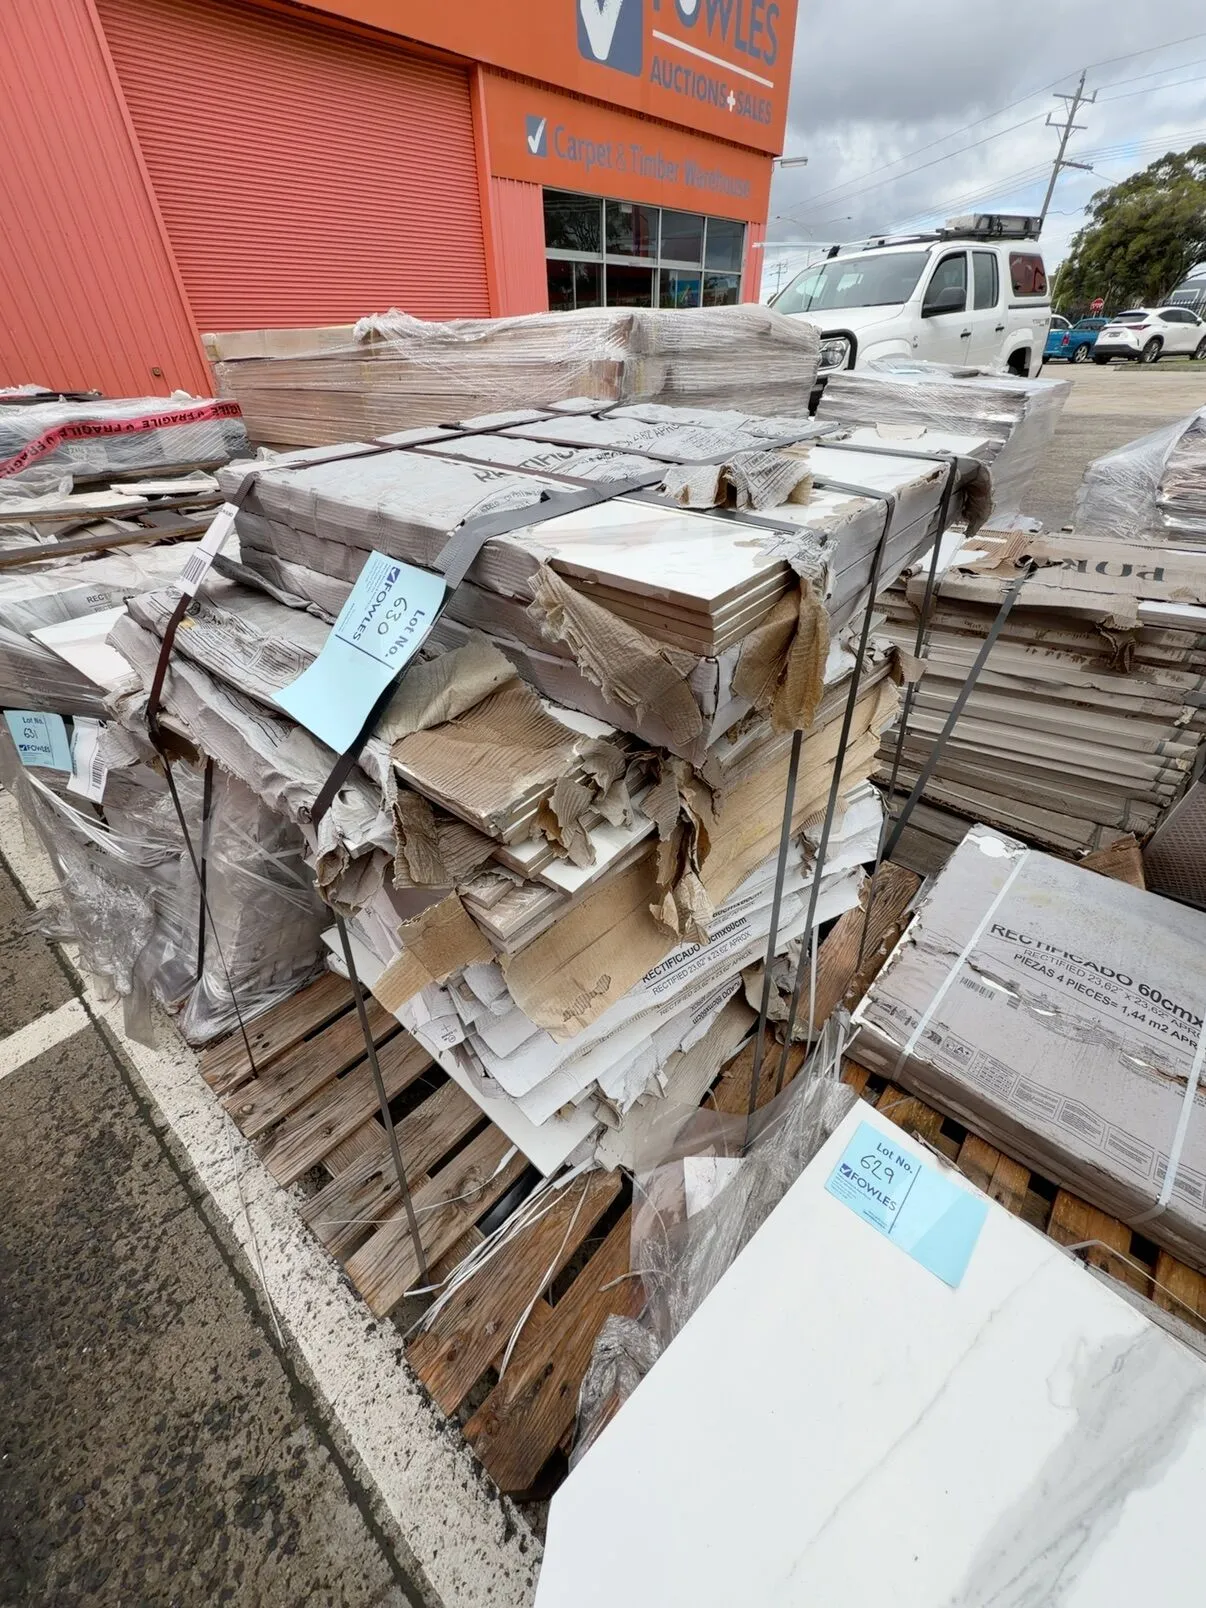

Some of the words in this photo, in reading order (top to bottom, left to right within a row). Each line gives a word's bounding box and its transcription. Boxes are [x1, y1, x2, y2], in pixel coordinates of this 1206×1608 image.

[652, 0, 780, 66] WLES
[554, 126, 612, 173] Carpet
[630, 142, 679, 182] Timber
[684, 159, 752, 198] Warehouse
[59, 424, 121, 439] FRAGILE
[141, 412, 197, 430] FRAGILE
[352, 582, 393, 641] FOWLES
[377, 597, 408, 636] 630
[404, 609, 426, 634] Lot
[384, 635, 409, 658] No.
[22, 716, 34, 724] Lot
[23, 727, 39, 740] 631
[26, 744, 51, 753] FOWLES
[652, 969, 689, 996] RECTIFIED
[728, 932, 752, 949] APROX
[990, 923, 1134, 987] RECTIFICADO
[1023, 948, 1087, 978] RECTIFIED
[1013, 953, 1055, 979] PIEZAS
[1056, 974, 1064, 983] 4
[1066, 978, 1119, 1009] PIECES=
[1122, 1005, 1146, 1023] 1,44
[1148, 1018, 1170, 1034] m2
[860, 1153, 895, 1185] 629
[876, 1142, 895, 1160] Lot
[895, 1155, 914, 1174] No.
[849, 1172, 897, 1212] FOWLES
